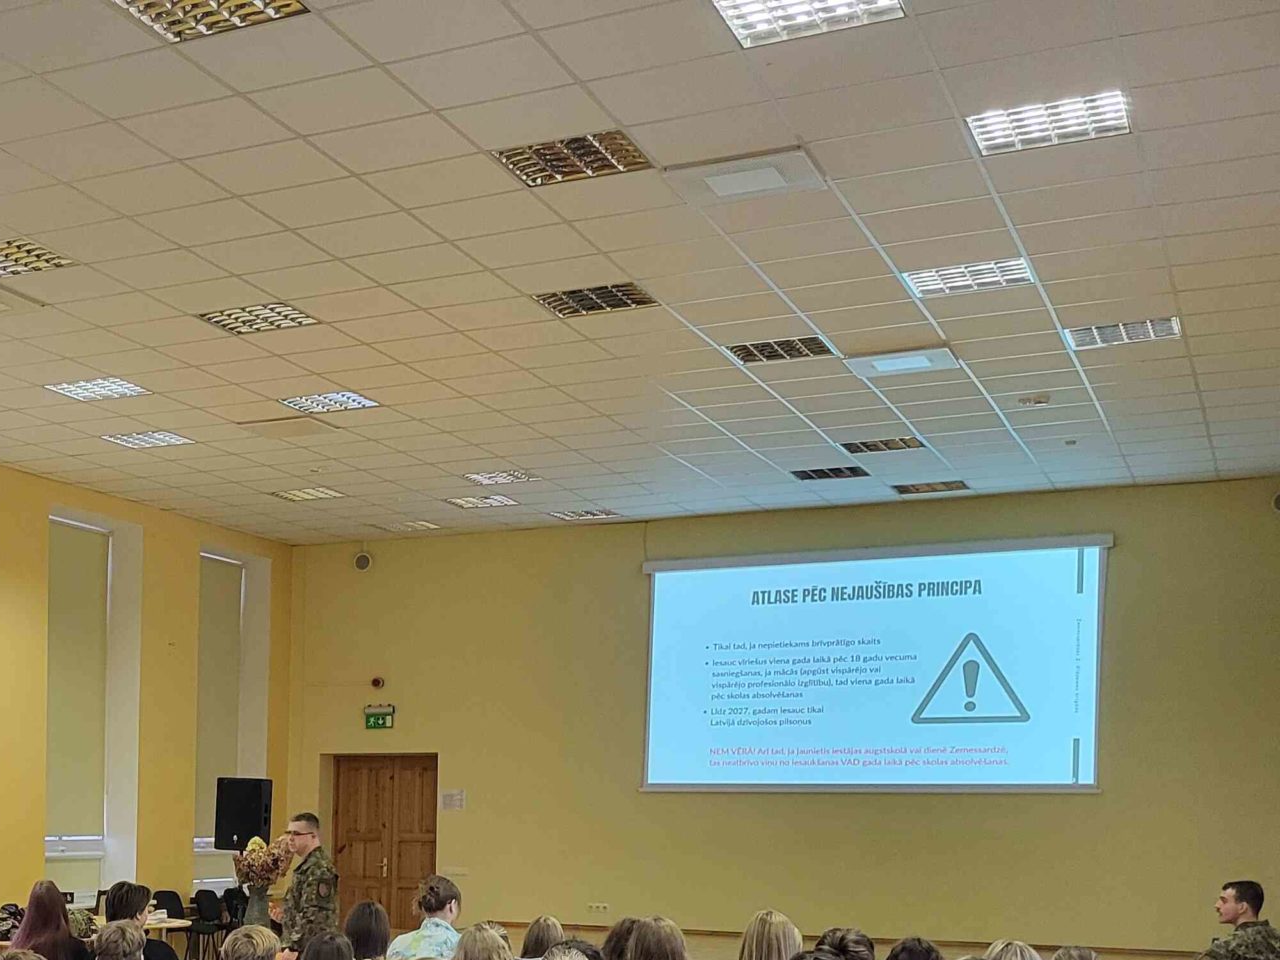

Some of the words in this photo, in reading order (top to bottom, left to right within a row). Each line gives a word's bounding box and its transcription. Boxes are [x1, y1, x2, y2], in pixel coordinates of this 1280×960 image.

[751, 588, 798, 606] ATLASE
[802, 585, 827, 603] PĒC
[831, 580, 913, 602] NEJAUŠĪBAS
[918, 579, 982, 598] PRINCIPA
